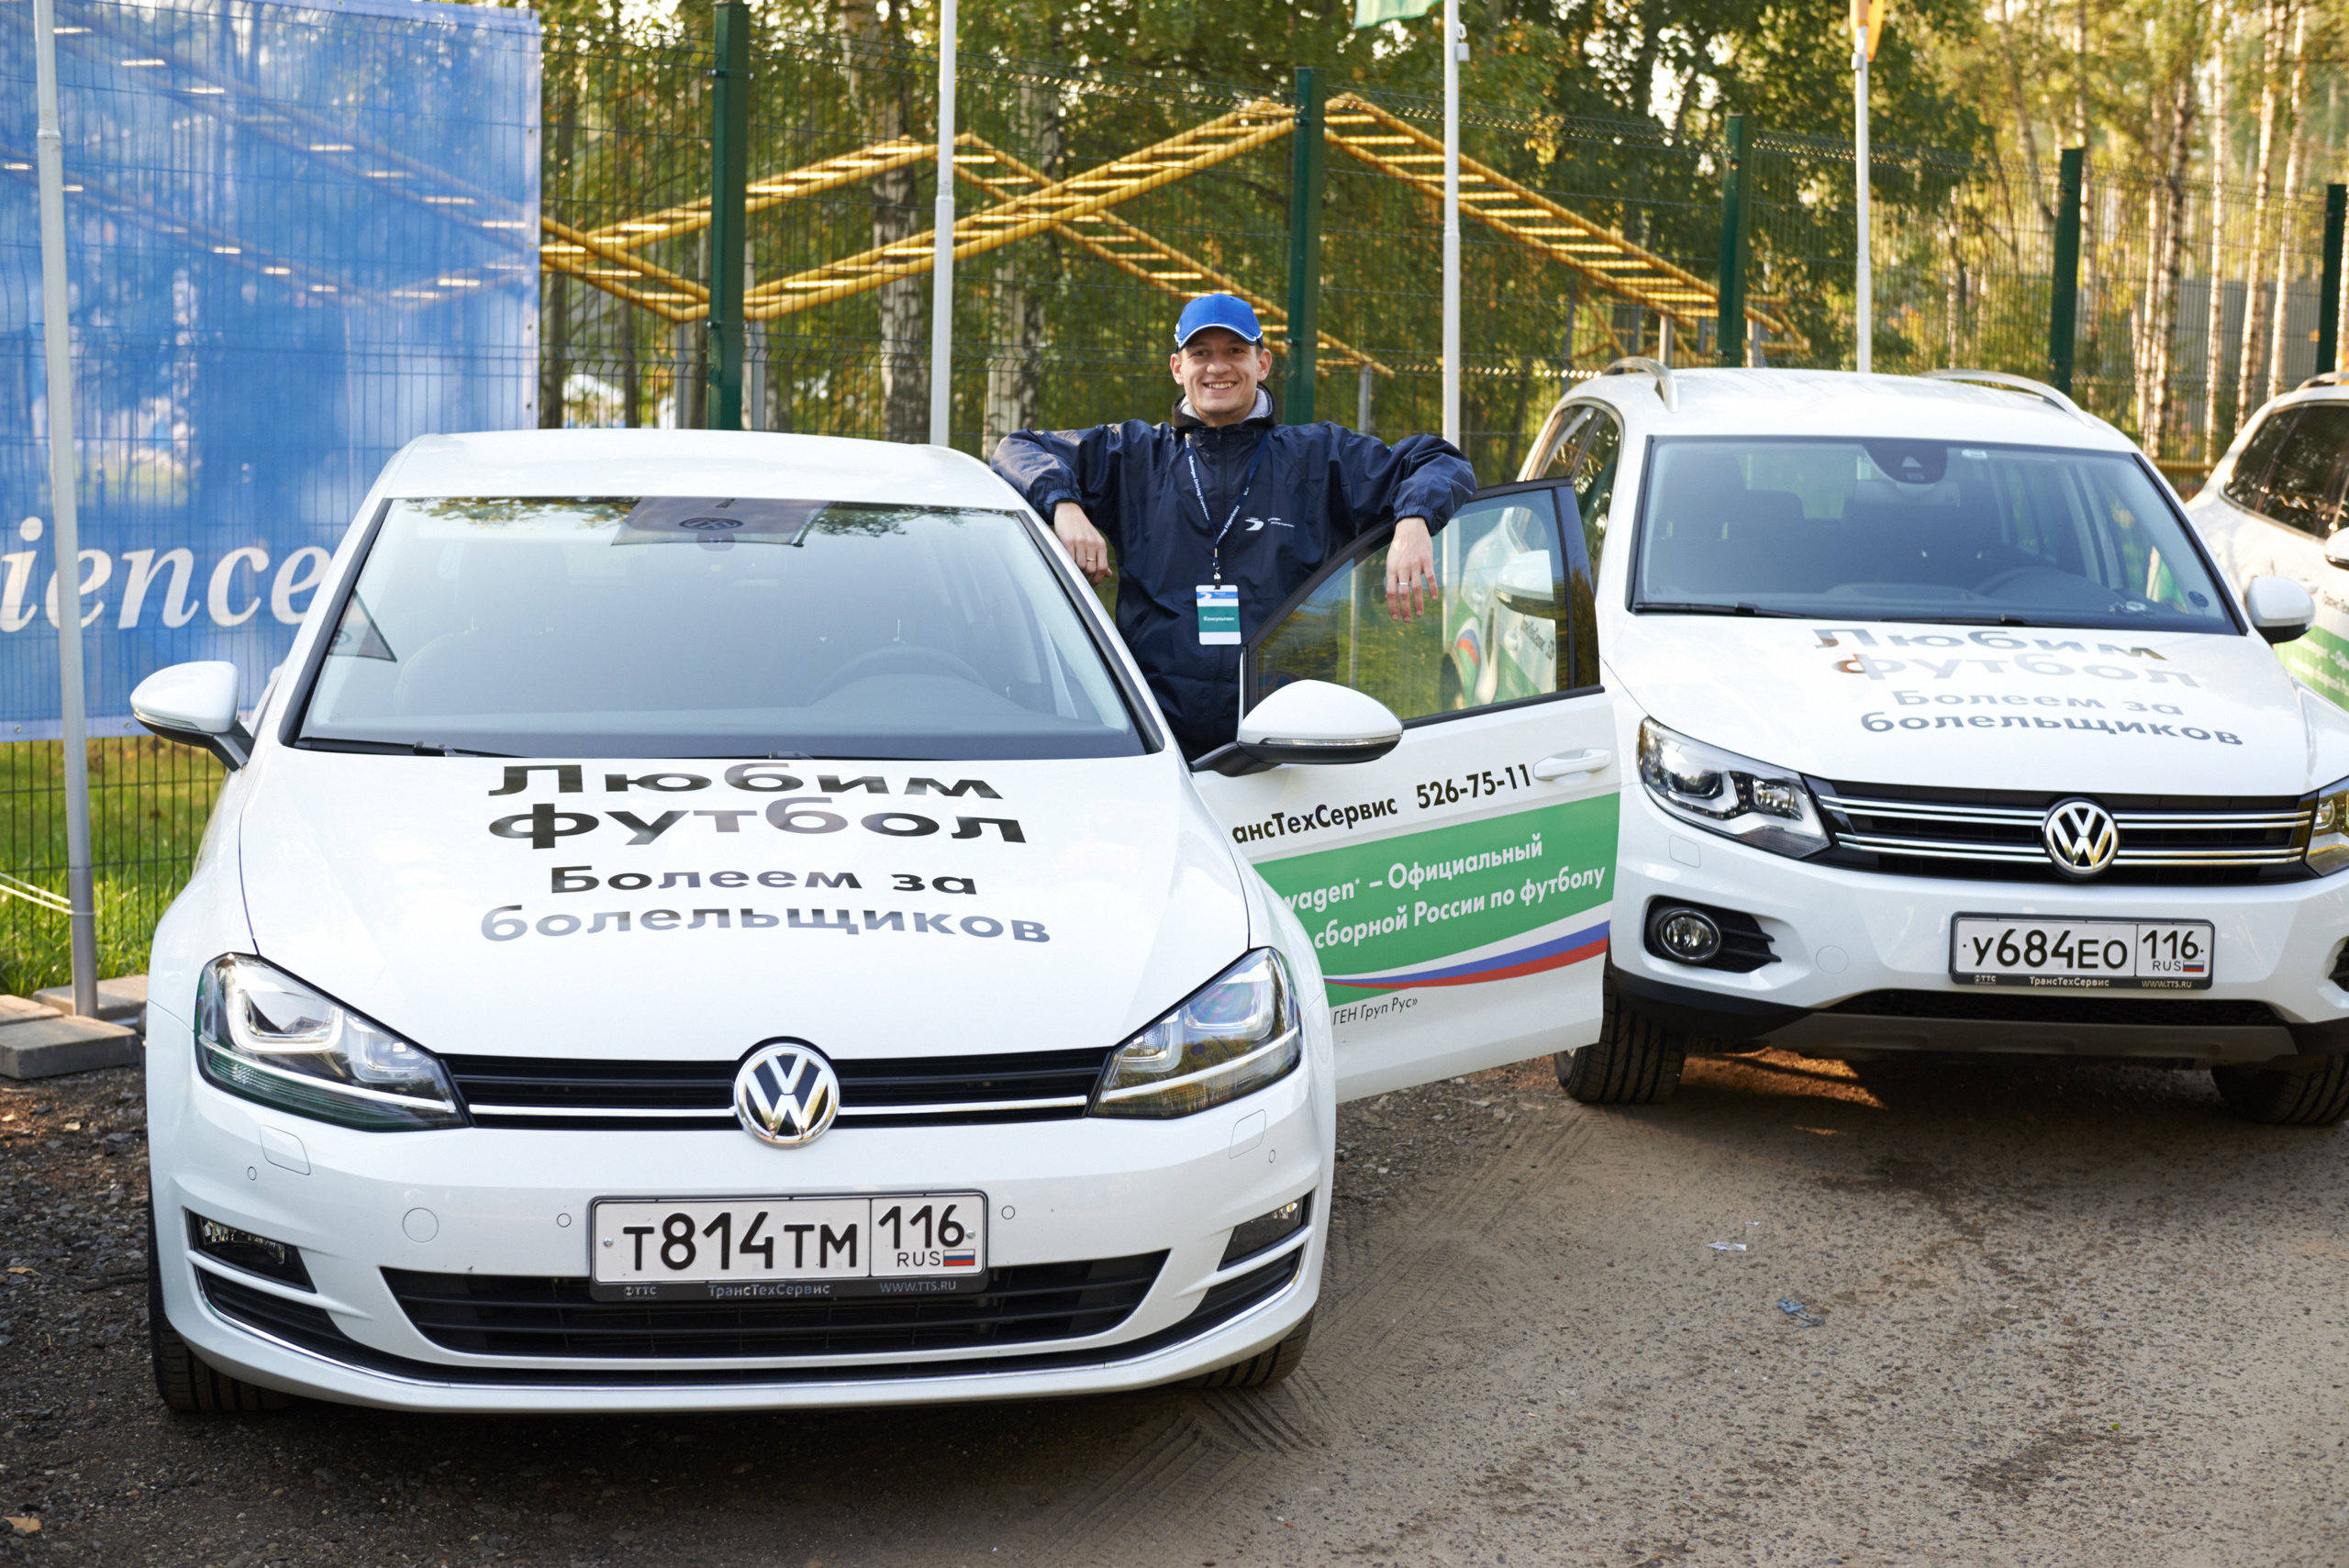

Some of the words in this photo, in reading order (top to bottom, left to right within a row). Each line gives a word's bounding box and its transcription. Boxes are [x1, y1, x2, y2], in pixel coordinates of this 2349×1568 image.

[0, 517, 331, 633] ience
[1812, 628, 2168, 661] Любим
[1831, 652, 2200, 688] футбол
[1891, 690, 2107, 709] Болеем
[2122, 700, 2185, 716] за
[1860, 711, 2243, 745] болельщиков
[488, 762, 1003, 800] Любим
[1231, 795, 1398, 844] ансТехСервис
[1416, 763, 1531, 809] 526-75-11
[488, 796, 1026, 850] футбол
[1386, 833, 1542, 891] Официальный
[551, 865, 863, 894] Болеем
[890, 873, 978, 895] за
[1314, 906, 1408, 949] сборной
[1413, 893, 1486, 927] России
[1490, 889, 1515, 909] по
[1520, 865, 1606, 906] футболу
[480, 905, 1052, 943] болельщиков
[2142, 929, 2199, 960] 116
[2029, 976, 2110, 987] ТрансТехСервис
[2152, 961, 2181, 972] RUS
[2141, 980, 2192, 988] WWW.TTS.RU
[1333, 1006, 1357, 1026] ГЕН
[1361, 1004, 1388, 1022] Груп
[1391, 996, 1418, 1014] Рус»
[879, 1204, 965, 1250] 116
[896, 1251, 941, 1268] RUS
[707, 1284, 830, 1298] ТрансТехСервис
[879, 1280, 957, 1293] WWW.TTS.RU
